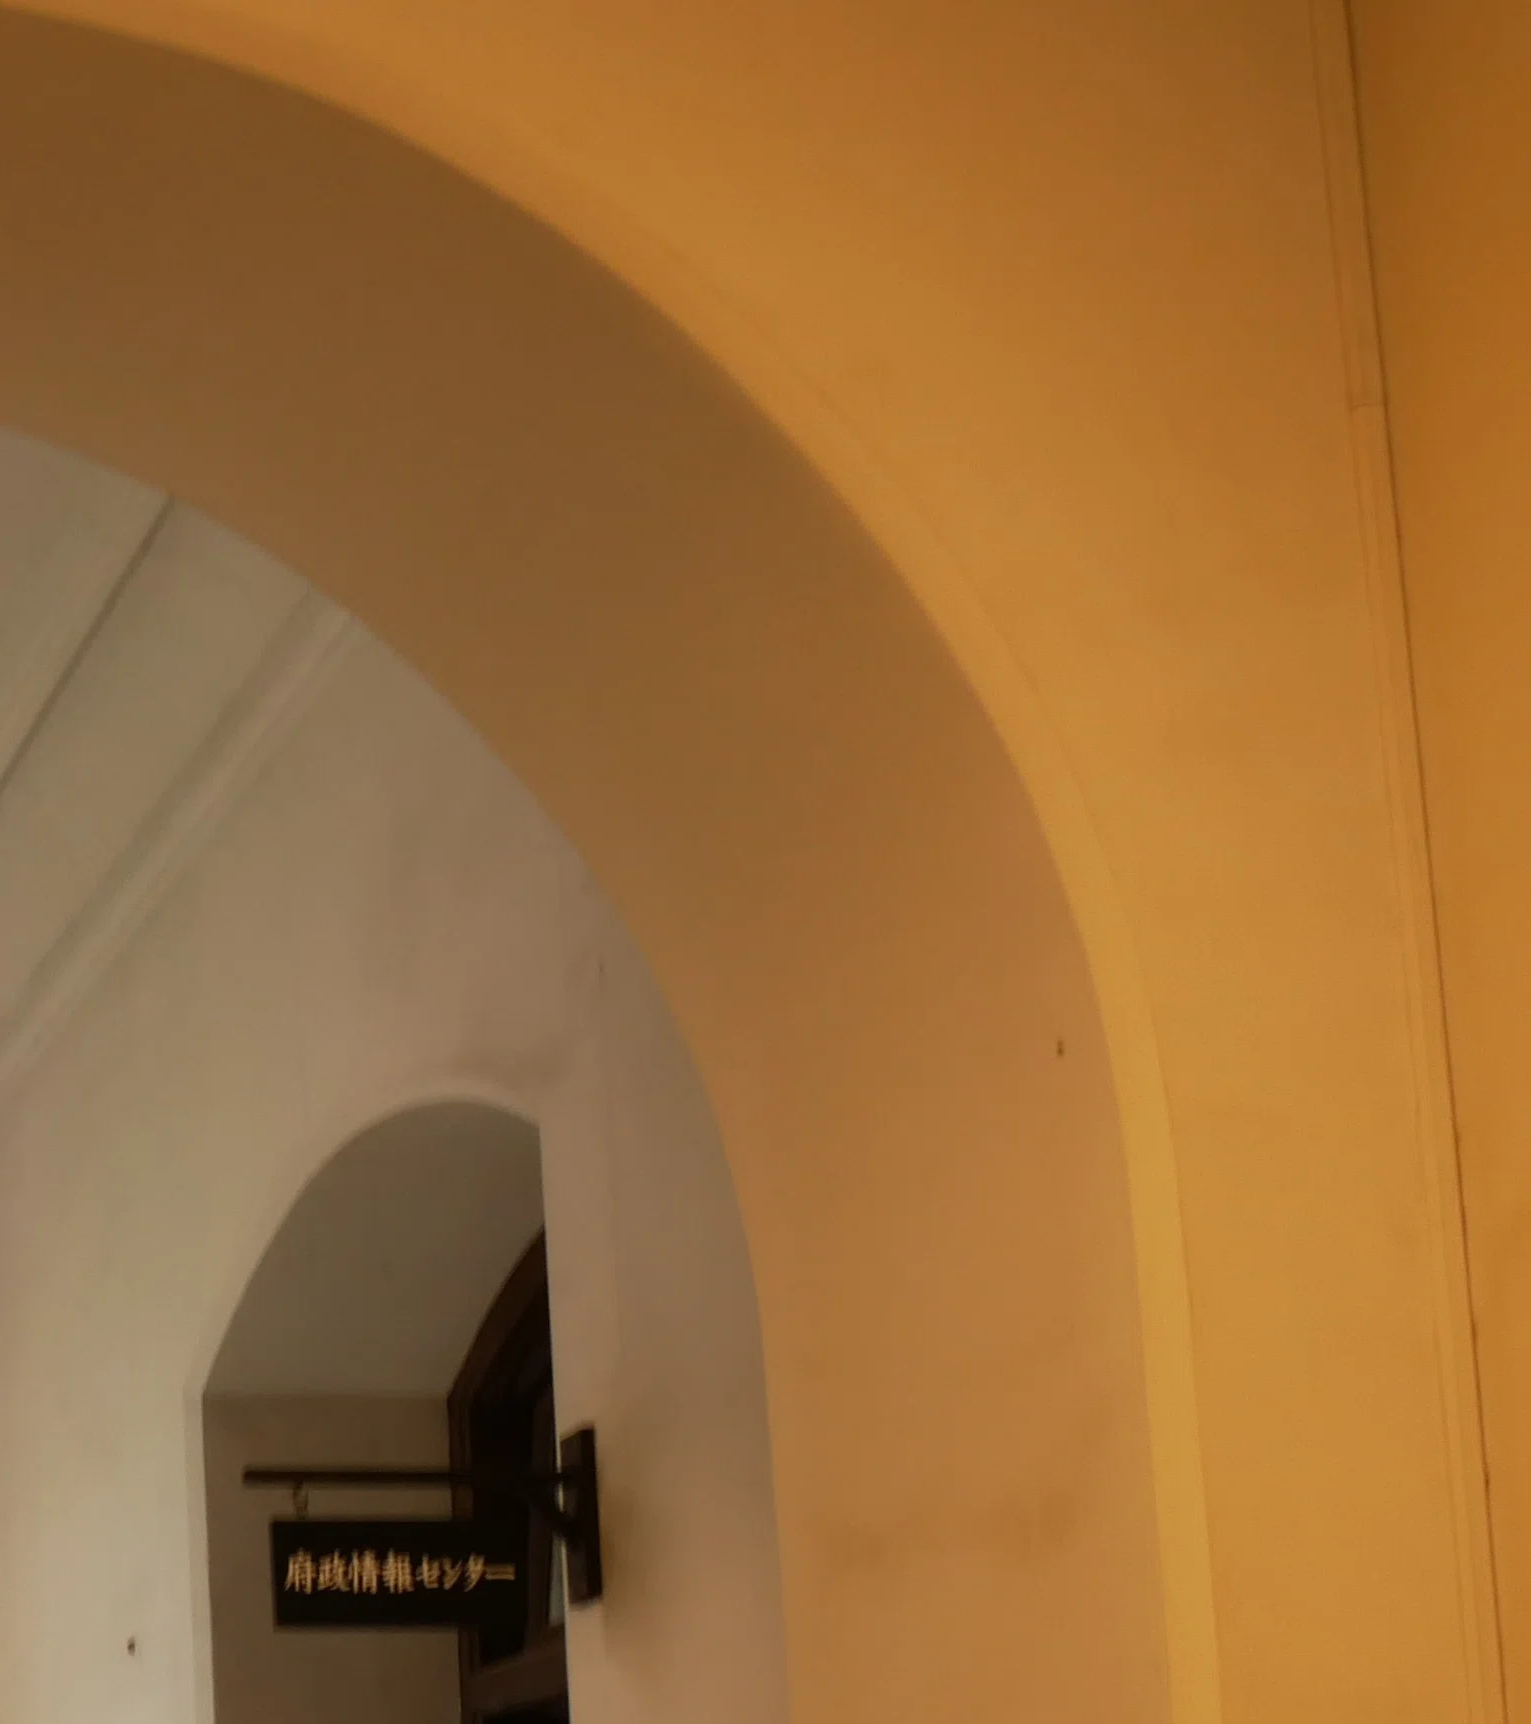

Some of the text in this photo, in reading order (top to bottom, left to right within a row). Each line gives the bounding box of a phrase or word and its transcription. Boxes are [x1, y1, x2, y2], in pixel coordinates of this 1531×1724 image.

[286, 1549, 516, 1594] 府政情報センター
